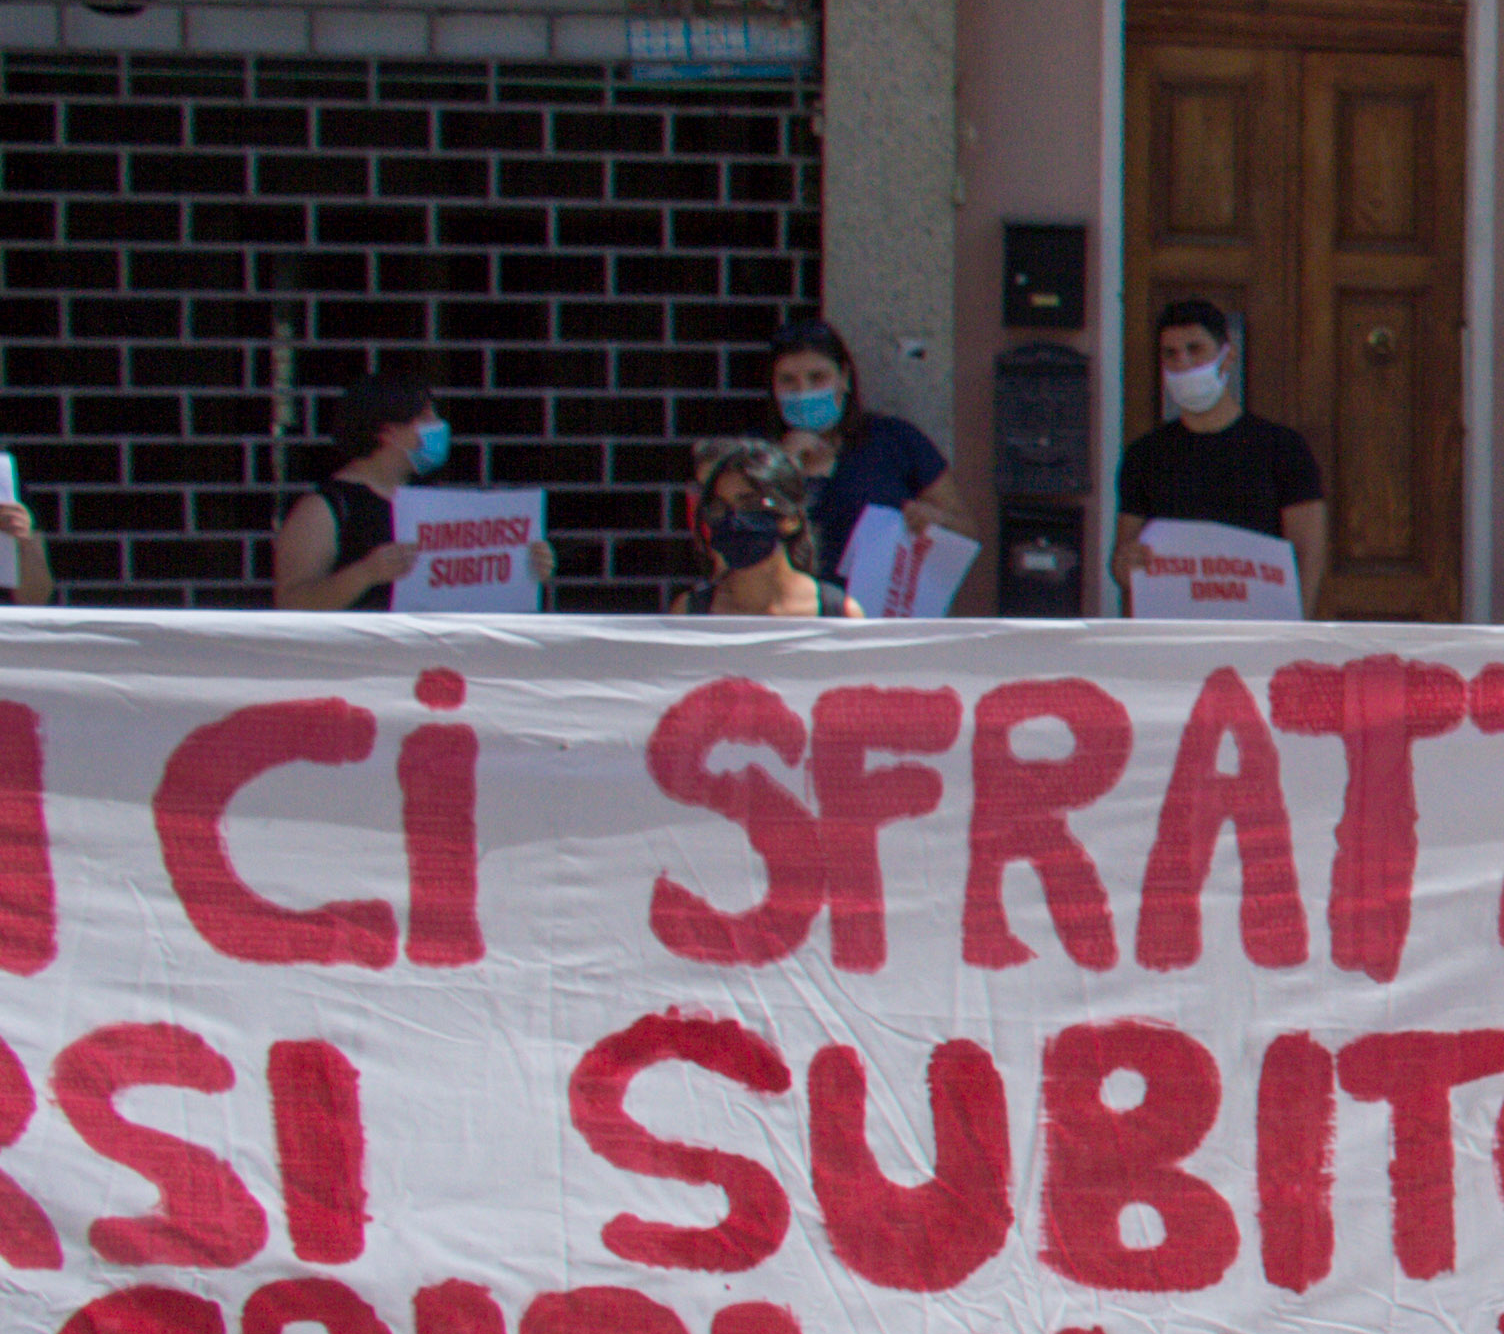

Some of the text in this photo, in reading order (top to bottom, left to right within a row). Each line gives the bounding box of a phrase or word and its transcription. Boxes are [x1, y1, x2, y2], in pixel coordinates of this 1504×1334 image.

[418, 516, 531, 551] RIMBORSI
[429, 553, 512, 588] SUBITO
[1201, 556, 1256, 577] BOGA
